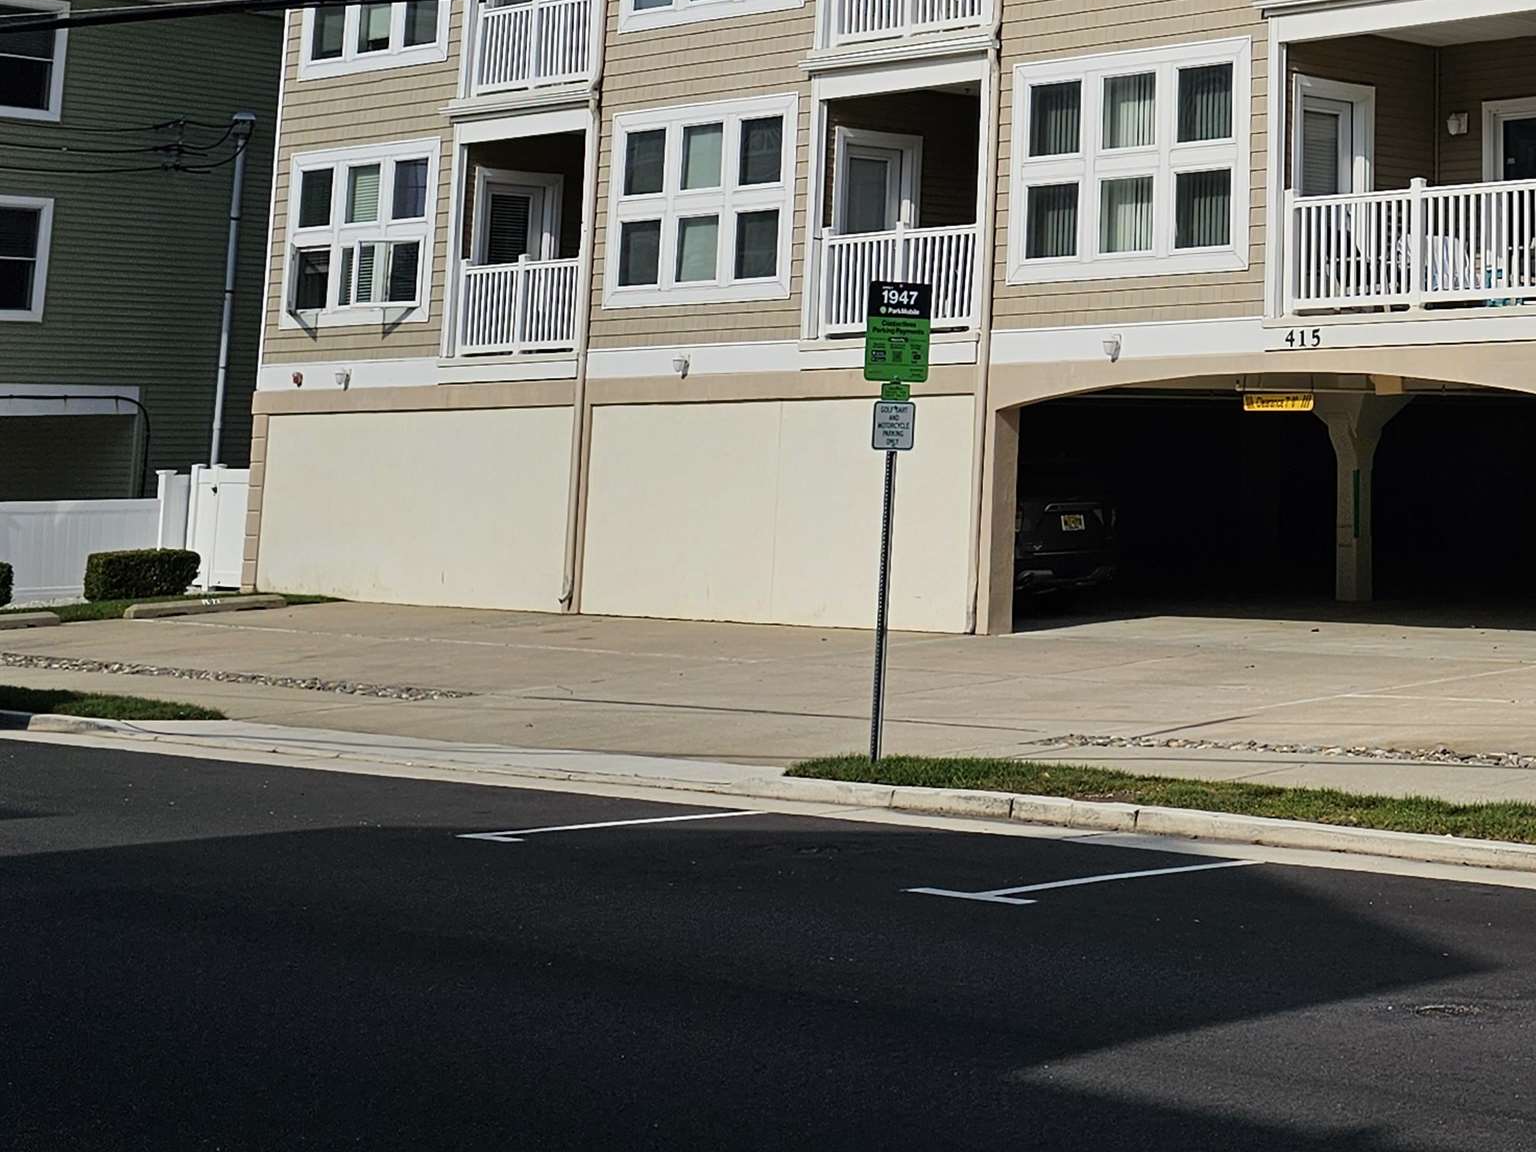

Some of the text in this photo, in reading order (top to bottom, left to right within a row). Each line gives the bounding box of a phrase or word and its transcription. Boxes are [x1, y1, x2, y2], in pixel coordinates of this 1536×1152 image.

[882, 289, 918, 305] 1947
[888, 307, 920, 315] ParkMobile
[872, 326, 895, 335] Parking
[1285, 328, 1321, 347] 415
[878, 422, 910, 430] MOTORCYCLE
[882, 430, 904, 438] PARKING
